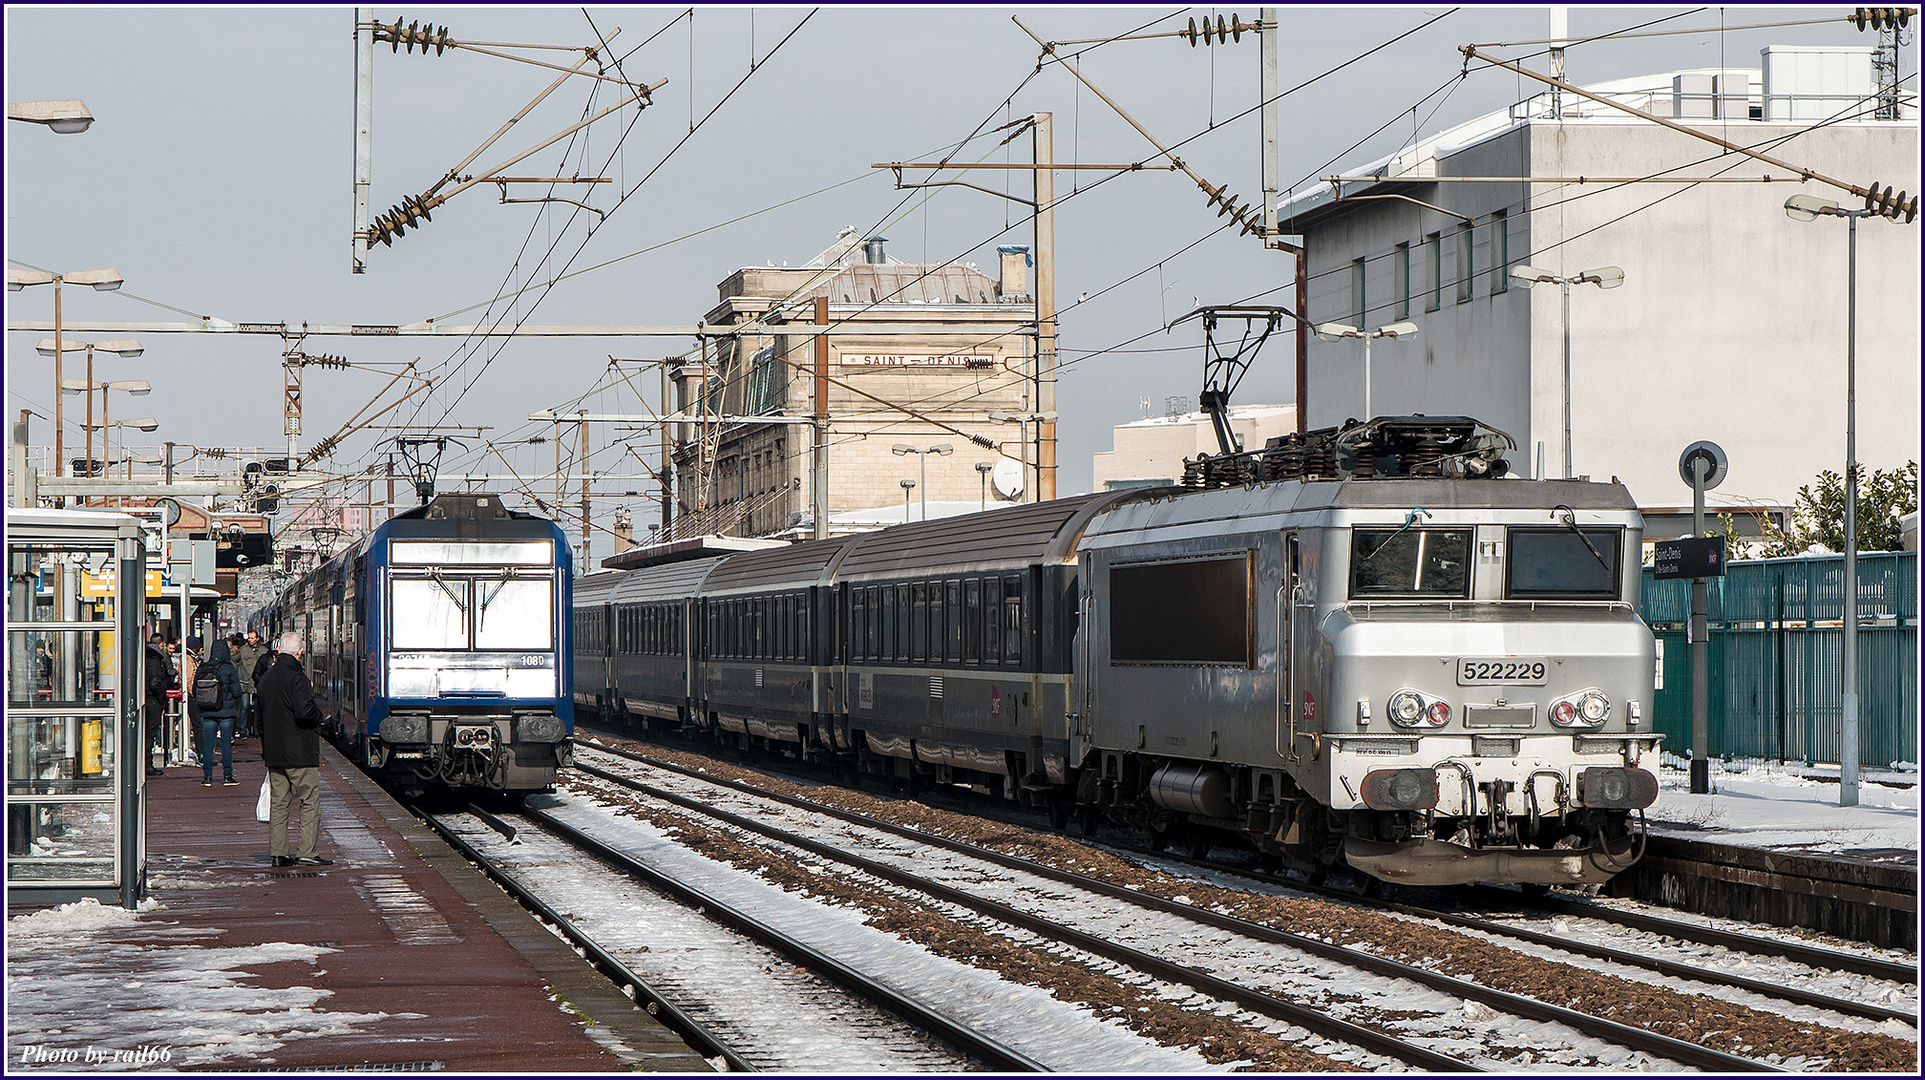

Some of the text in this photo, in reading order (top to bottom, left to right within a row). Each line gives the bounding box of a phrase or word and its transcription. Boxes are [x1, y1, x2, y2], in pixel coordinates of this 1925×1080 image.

[864, 356, 905, 366] SAINT
[1655, 546, 1682, 561] Saint-Denis
[521, 655, 545, 666] 108D
[1463, 662, 1546, 680] 522229
